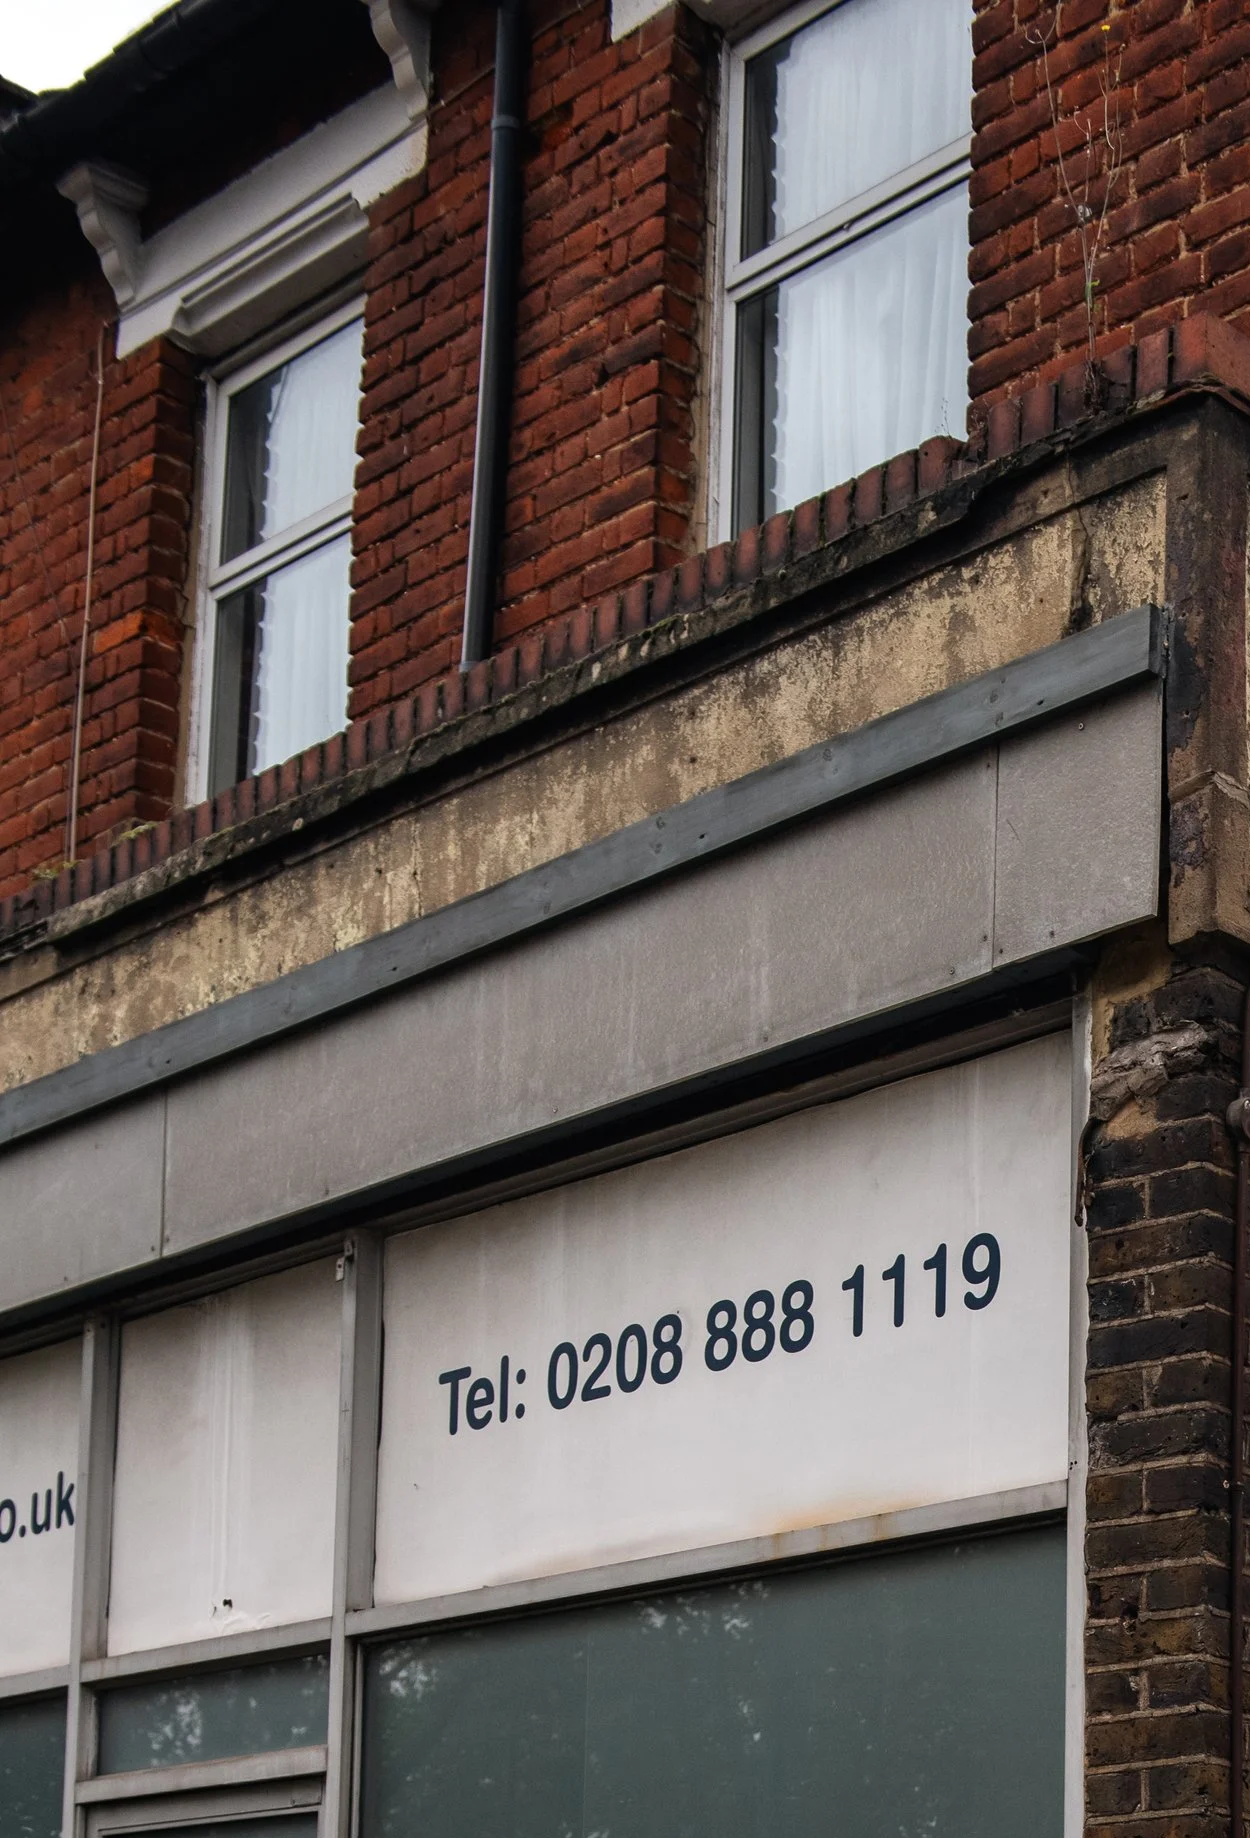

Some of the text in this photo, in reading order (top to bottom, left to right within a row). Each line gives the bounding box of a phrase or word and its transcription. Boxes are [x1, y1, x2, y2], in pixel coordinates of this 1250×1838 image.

[439, 1232, 1001, 1436] Tel: 0208 888 1119
